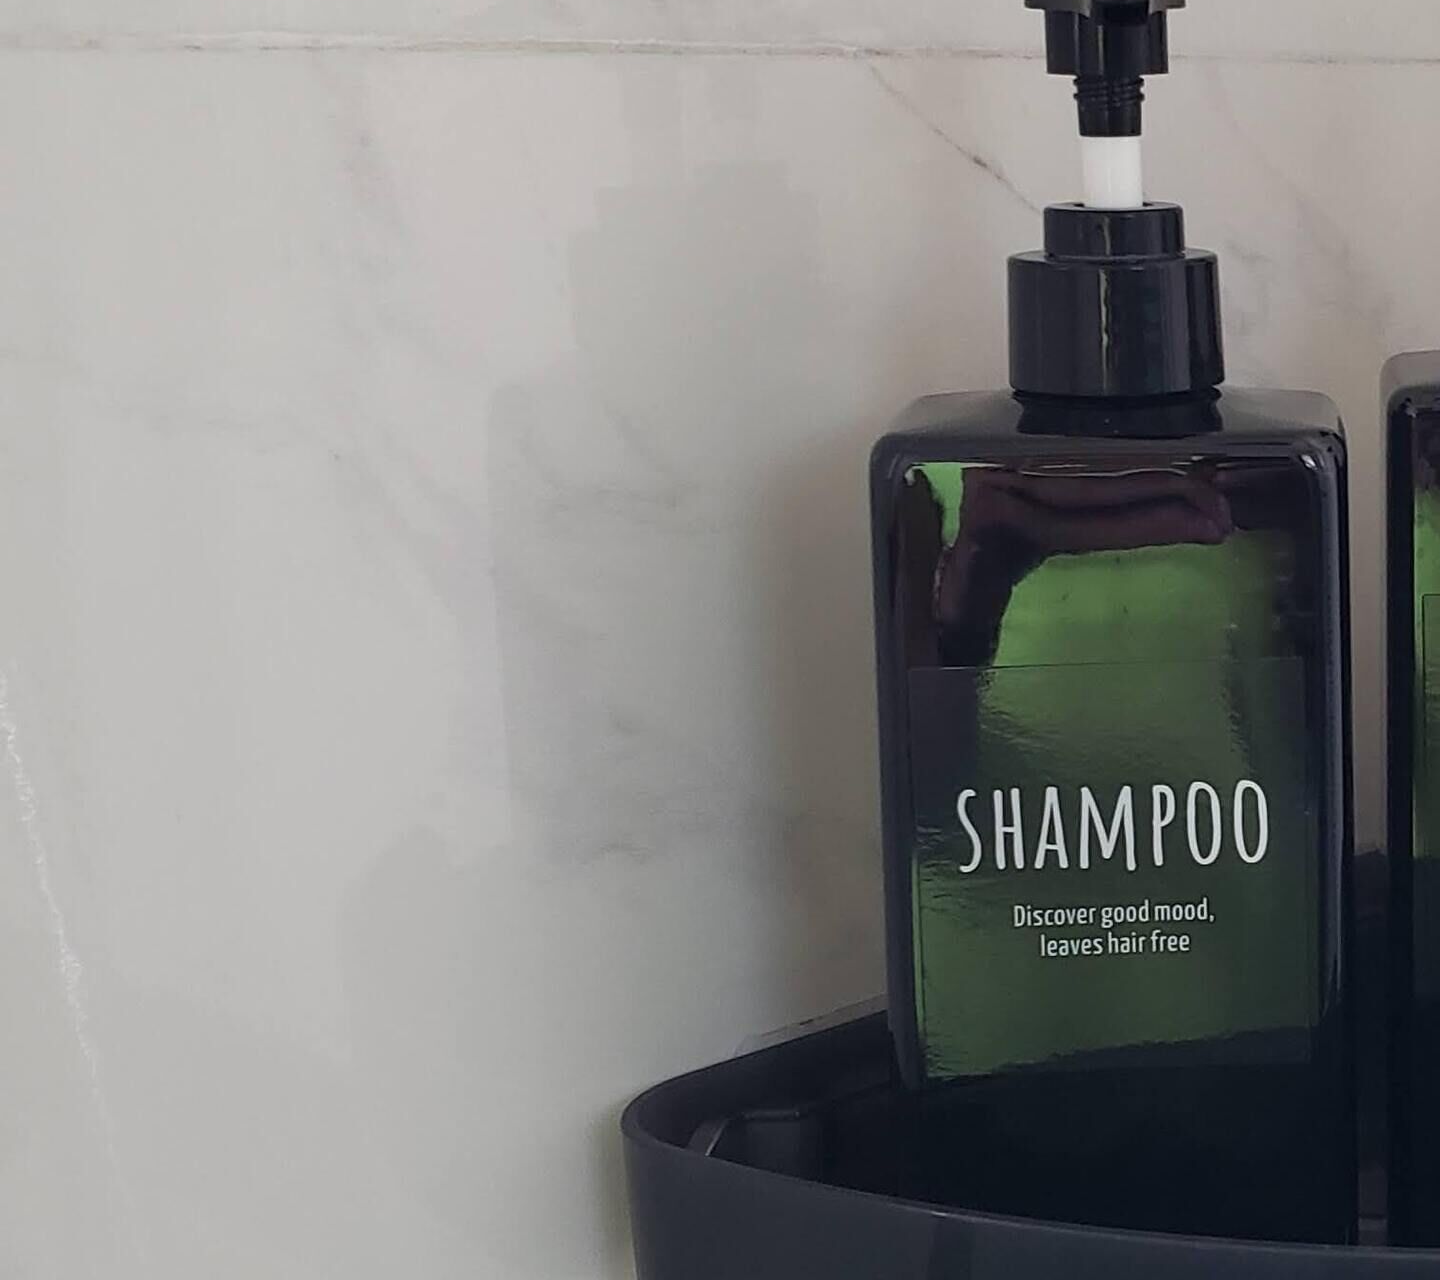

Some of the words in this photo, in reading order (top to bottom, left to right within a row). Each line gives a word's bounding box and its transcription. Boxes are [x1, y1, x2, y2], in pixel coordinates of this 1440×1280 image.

[956, 779, 1269, 873] SHAMPOO
[1013, 904, 1097, 928] Discover
[1101, 899, 1150, 928] good
[1154, 897, 1216, 924] mood,
[1040, 933, 1103, 957] leaves
[1108, 931, 1147, 954] hair
[1150, 930, 1191, 952] free
